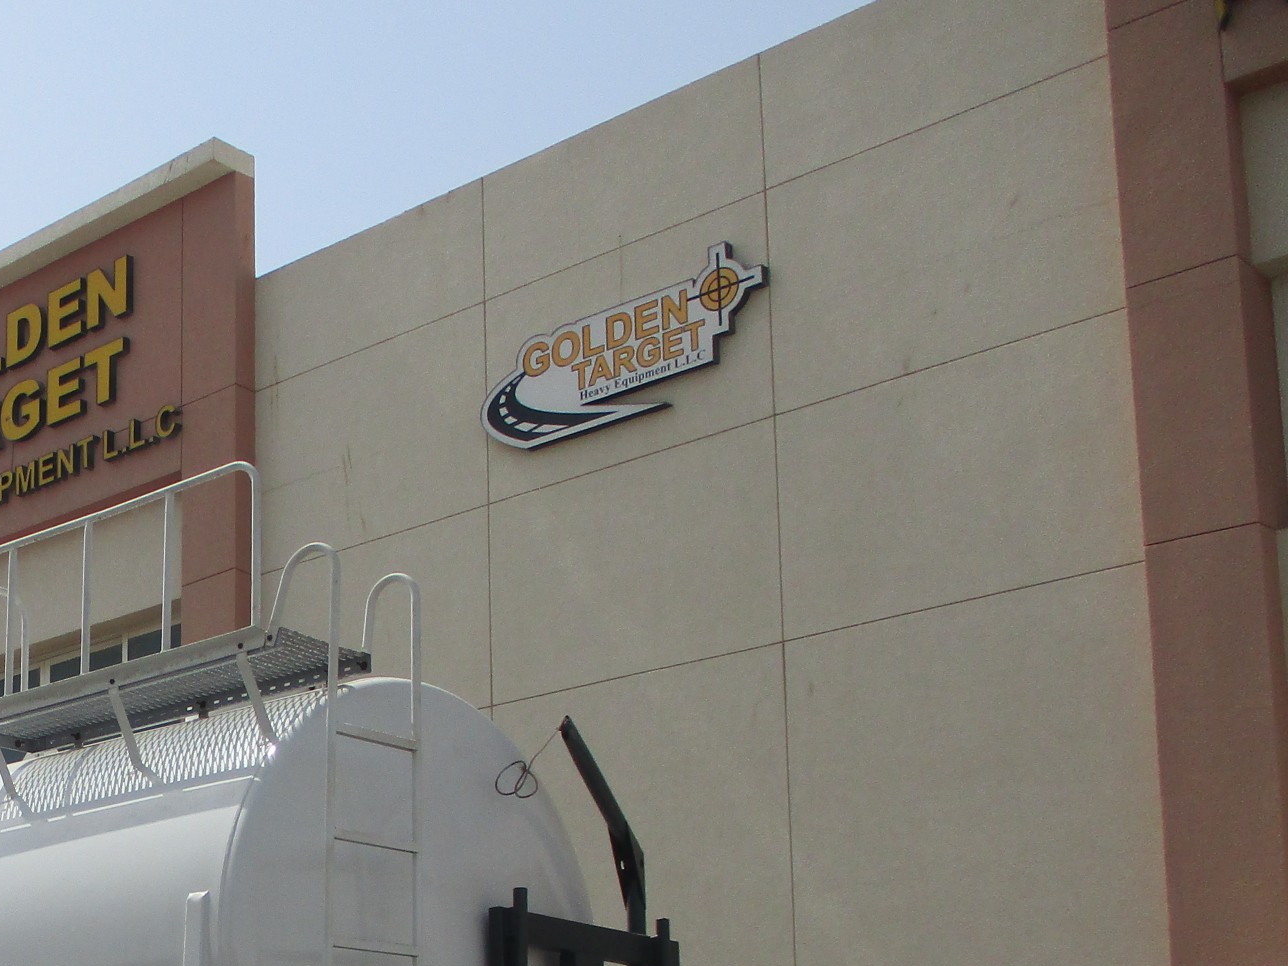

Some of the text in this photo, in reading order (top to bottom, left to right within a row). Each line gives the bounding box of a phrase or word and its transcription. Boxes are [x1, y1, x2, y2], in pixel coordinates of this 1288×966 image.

[522, 288, 689, 377] GOLDEN
[571, 319, 706, 391] TARGET
[579, 348, 706, 401] Heavy Equipment L.L.C
[102, 404, 183, 462] L.L.C
